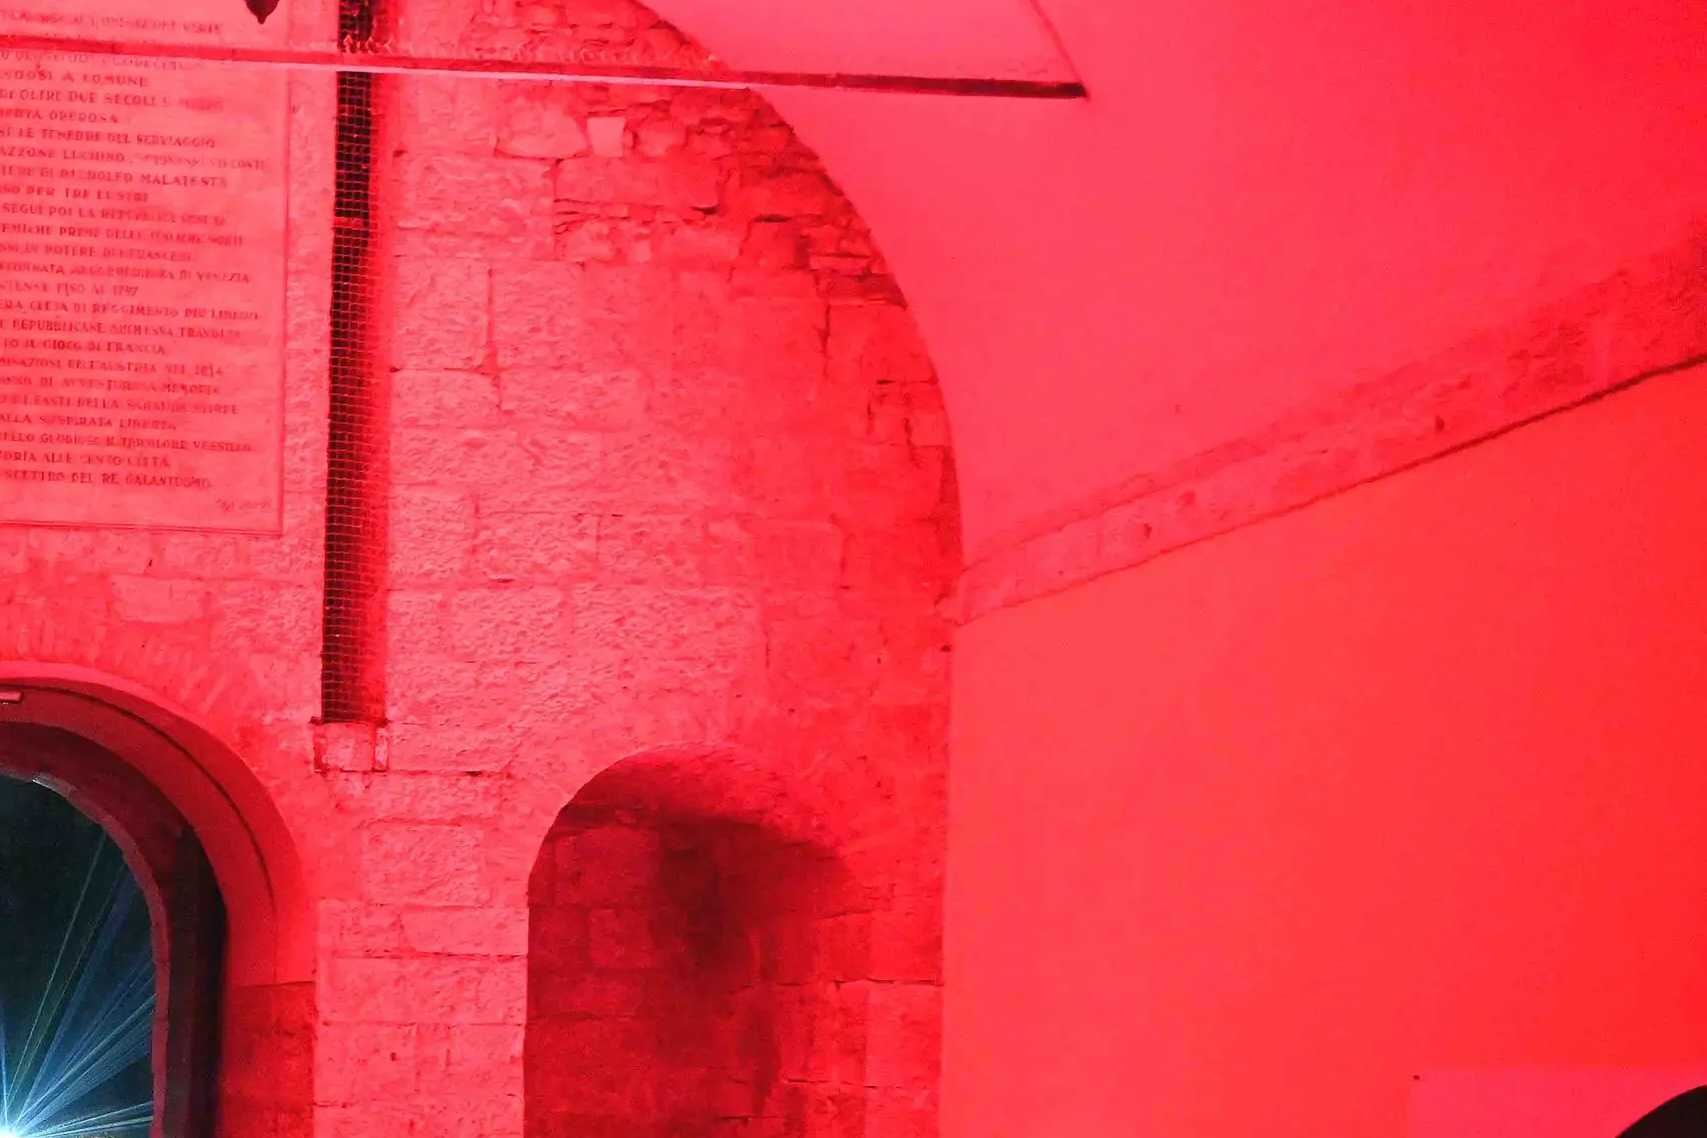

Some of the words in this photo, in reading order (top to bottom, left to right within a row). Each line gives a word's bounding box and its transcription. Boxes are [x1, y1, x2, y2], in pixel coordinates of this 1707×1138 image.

[68, 91, 97, 103] DUE
[105, 93, 156, 107] SECOLI
[49, 110, 119, 124] OPEROSA
[18, 127, 33, 139] LE
[41, 128, 100, 142] TENEBRE
[141, 173, 228, 188] MALATESTA
[27, 186, 55, 197] PER
[65, 188, 89, 199] TRE
[49, 206, 72, 217] POI
[79, 207, 95, 218] LA
[45, 244, 95, 257] POTERE
[74, 302, 87, 313] DI
[107, 342, 165, 355] FRANCIA
[40, 377, 53, 387] DI
[78, 397, 119, 409] DELLA
[0, 413, 32, 424] ALLA
[71, 472, 94, 483] DEL
